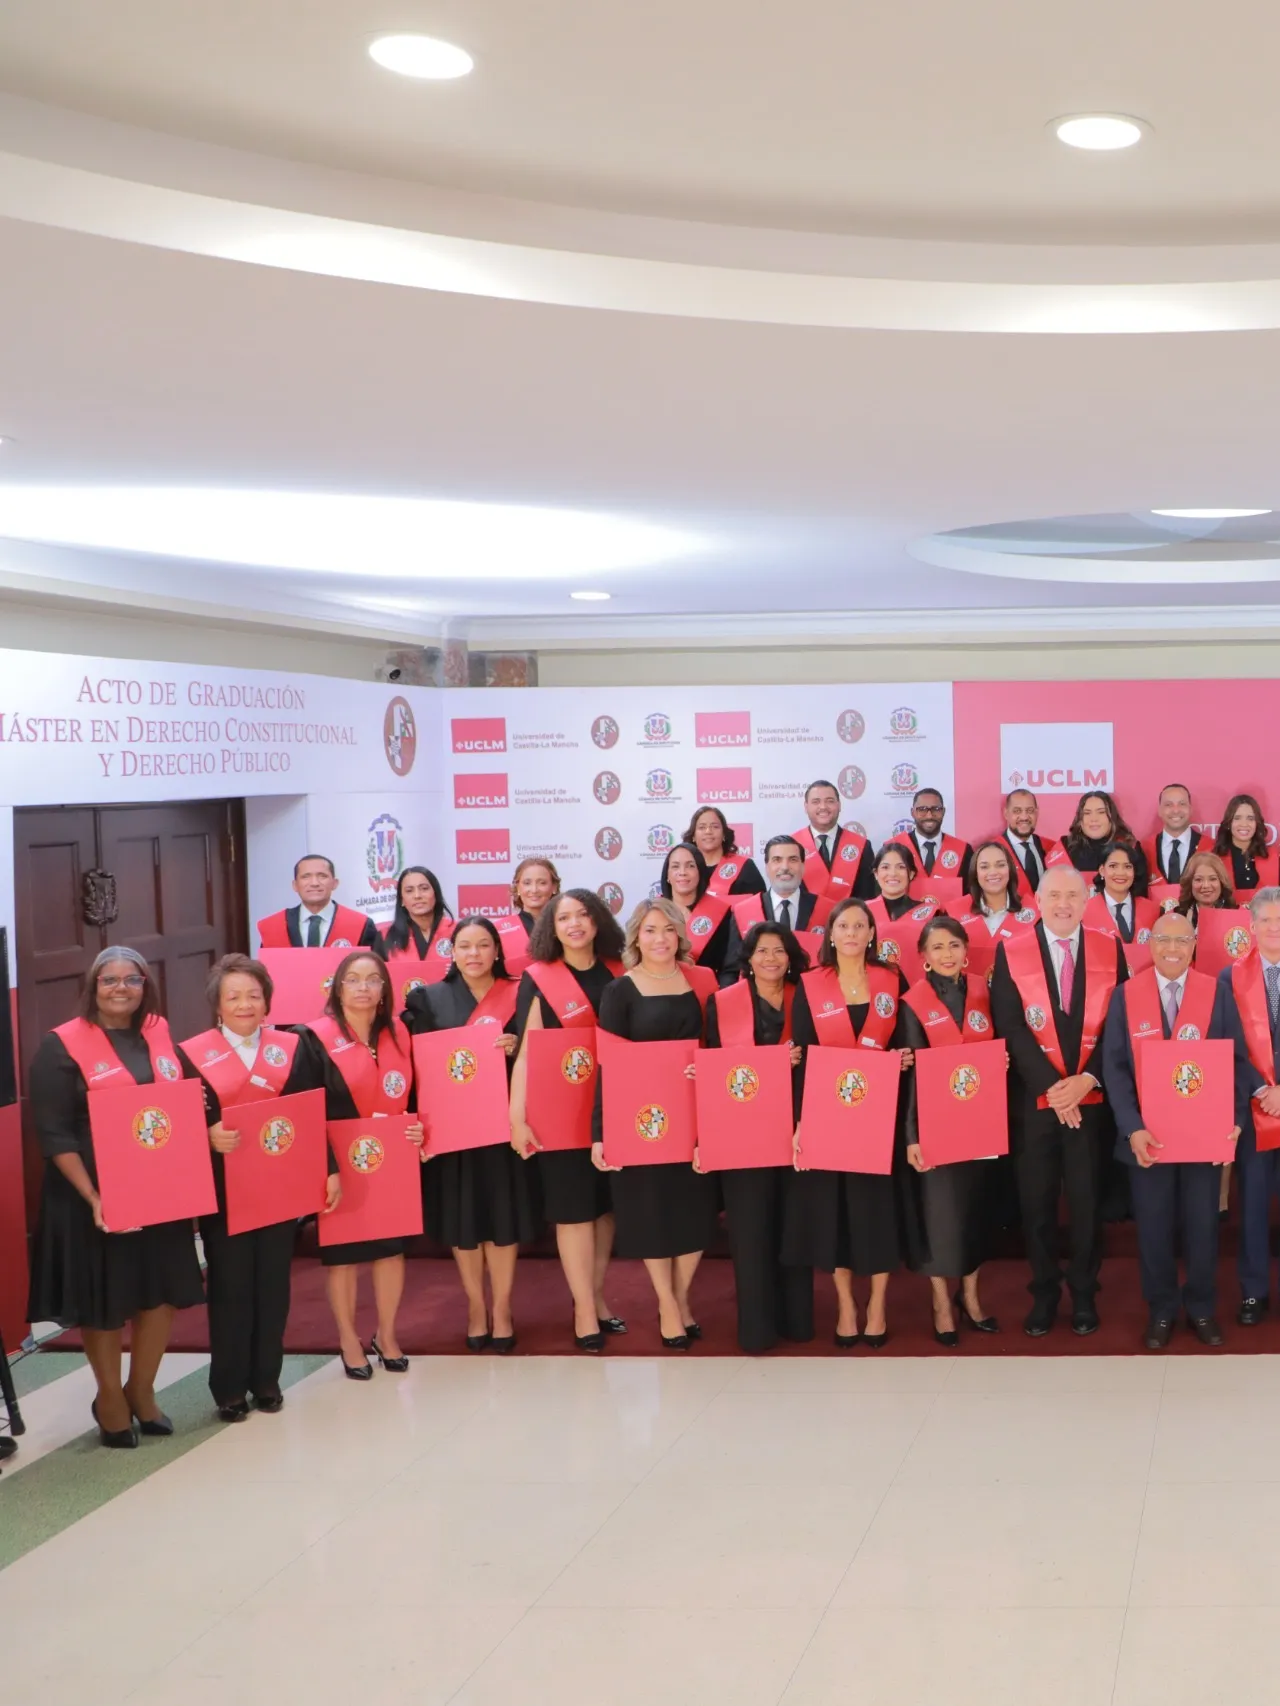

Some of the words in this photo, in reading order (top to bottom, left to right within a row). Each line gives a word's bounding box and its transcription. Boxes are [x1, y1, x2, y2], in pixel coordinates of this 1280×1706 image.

[76, 676, 142, 704] ACTO
[149, 681, 177, 706] DE
[187, 681, 305, 710] GRADUACIÓN
[91, 719, 120, 742] EN
[126, 716, 220, 743] DERECHO
[225, 717, 358, 745] CONSTITUCIONAL
[708, 734, 748, 744] UCLM
[465, 740, 504, 750] UCLM
[97, 753, 115, 777] Y
[121, 750, 216, 777] DERECHO
[220, 747, 291, 773] PÚBLICO
[1026, 769, 1107, 787] UCLM
[709, 790, 750, 800] UCLM
[466, 796, 506, 806] UCLM
[468, 850, 508, 860] UCLM
[470, 906, 510, 916] UCLM
